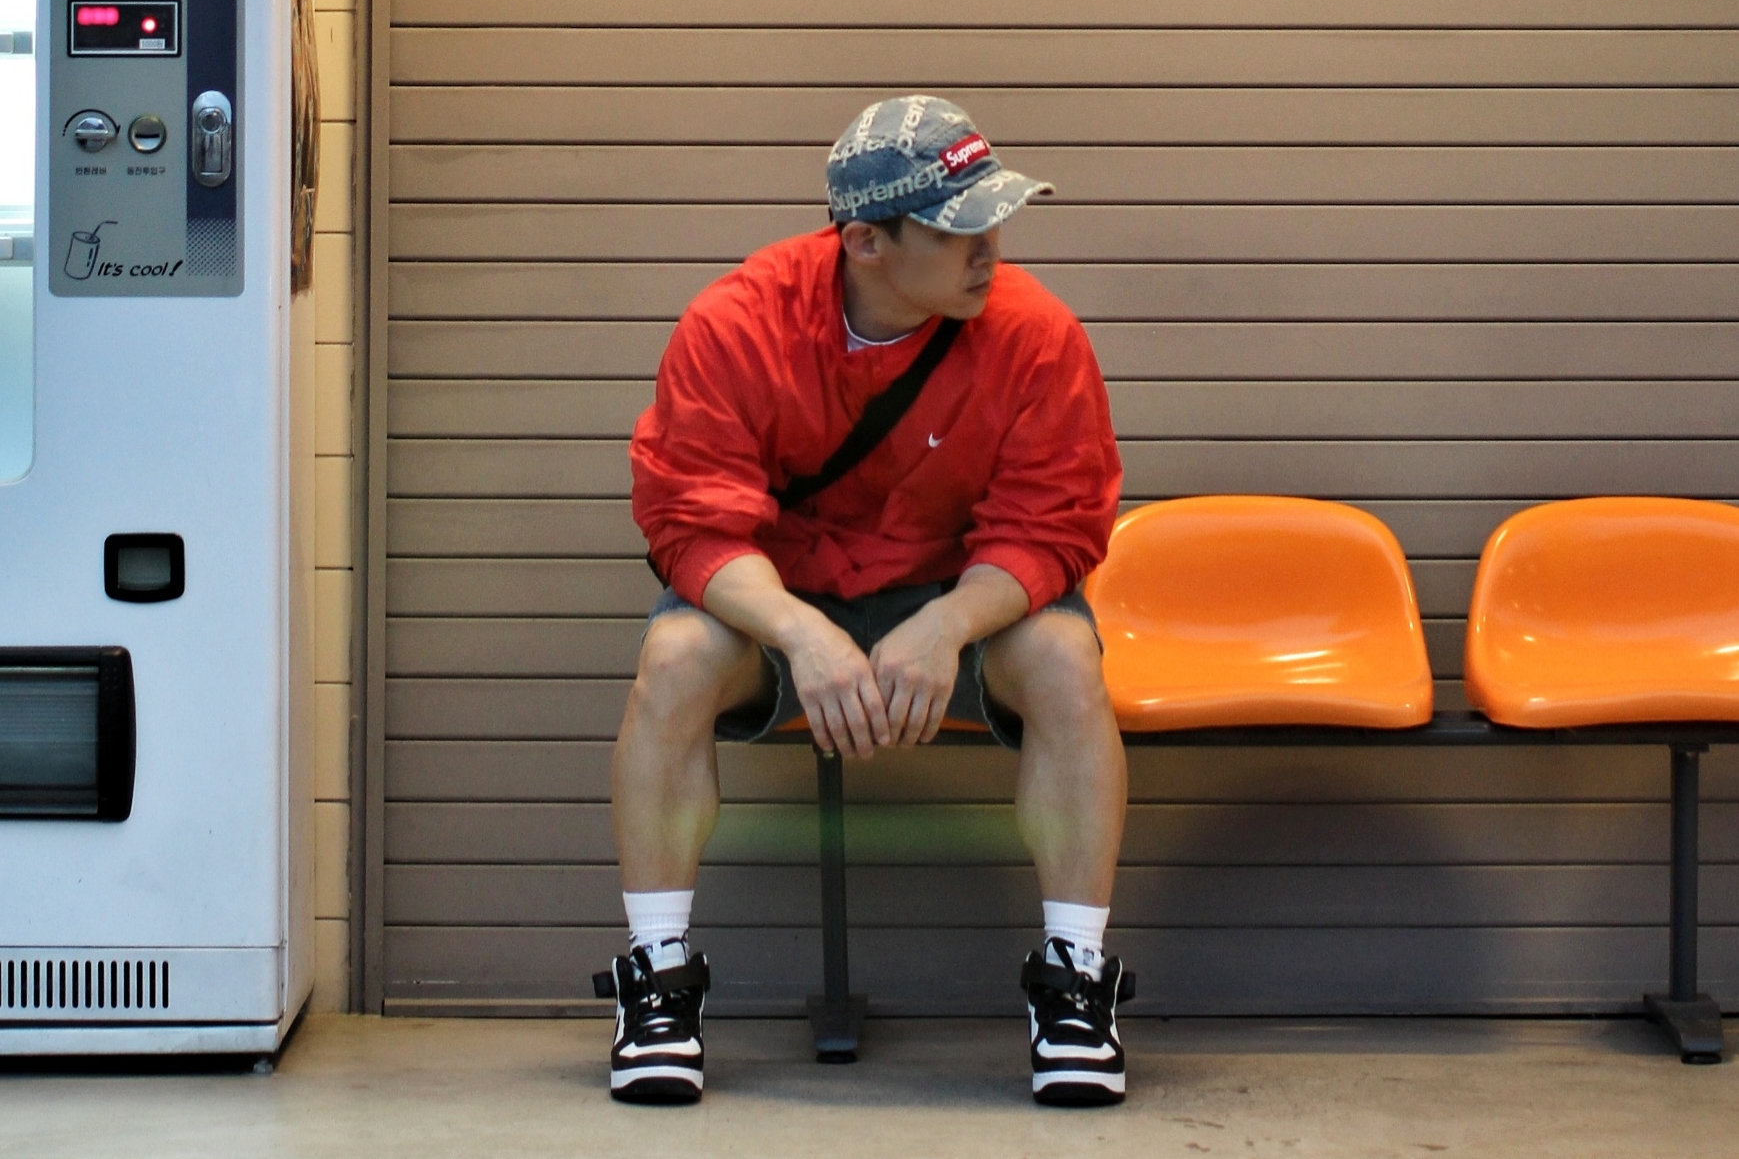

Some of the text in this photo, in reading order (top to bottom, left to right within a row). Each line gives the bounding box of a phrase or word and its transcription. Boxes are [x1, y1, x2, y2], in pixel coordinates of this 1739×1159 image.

[945, 139, 986, 167] Supreme
[97, 259, 184, 277] It's cool!
